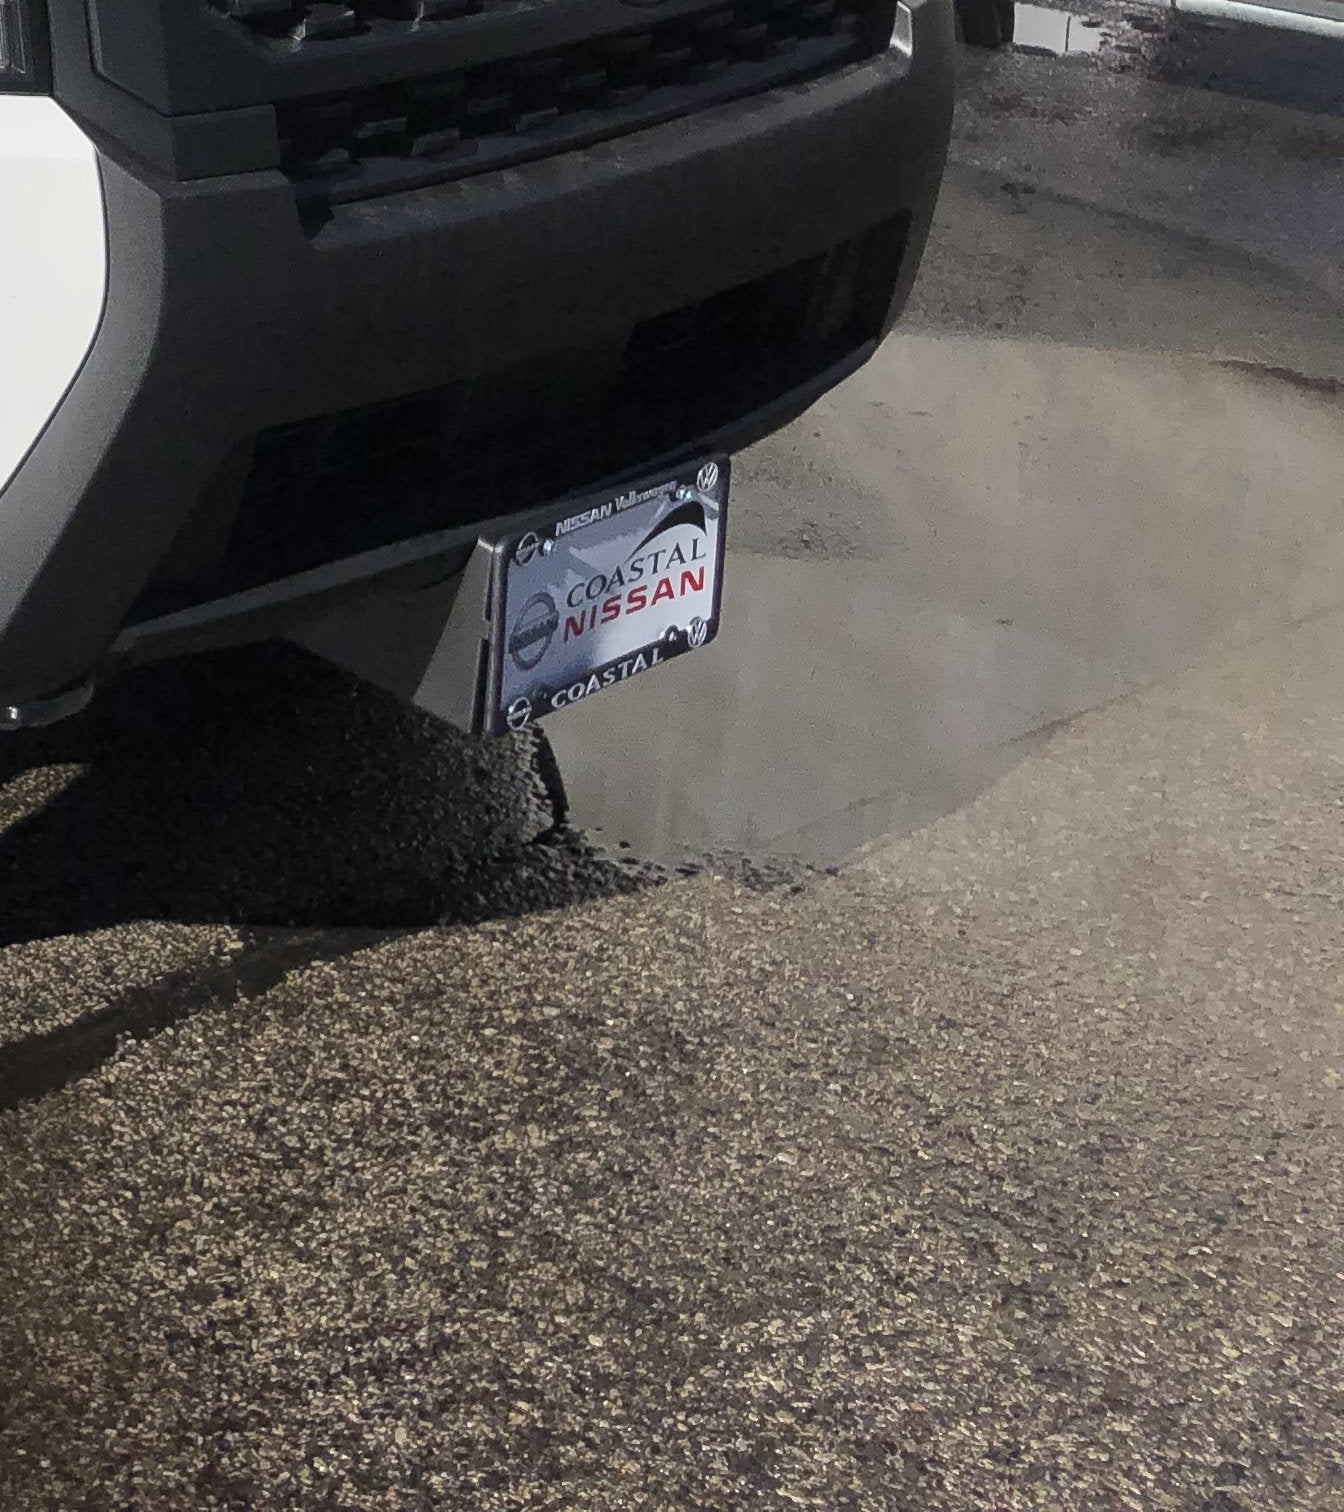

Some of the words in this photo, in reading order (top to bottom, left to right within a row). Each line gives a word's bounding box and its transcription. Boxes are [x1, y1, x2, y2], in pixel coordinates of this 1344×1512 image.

[554, 502, 612, 537] NISSAN
[562, 565, 706, 643] NISSAN
[566, 537, 707, 609] COASTAL
[550, 647, 664, 709] COASTAL
